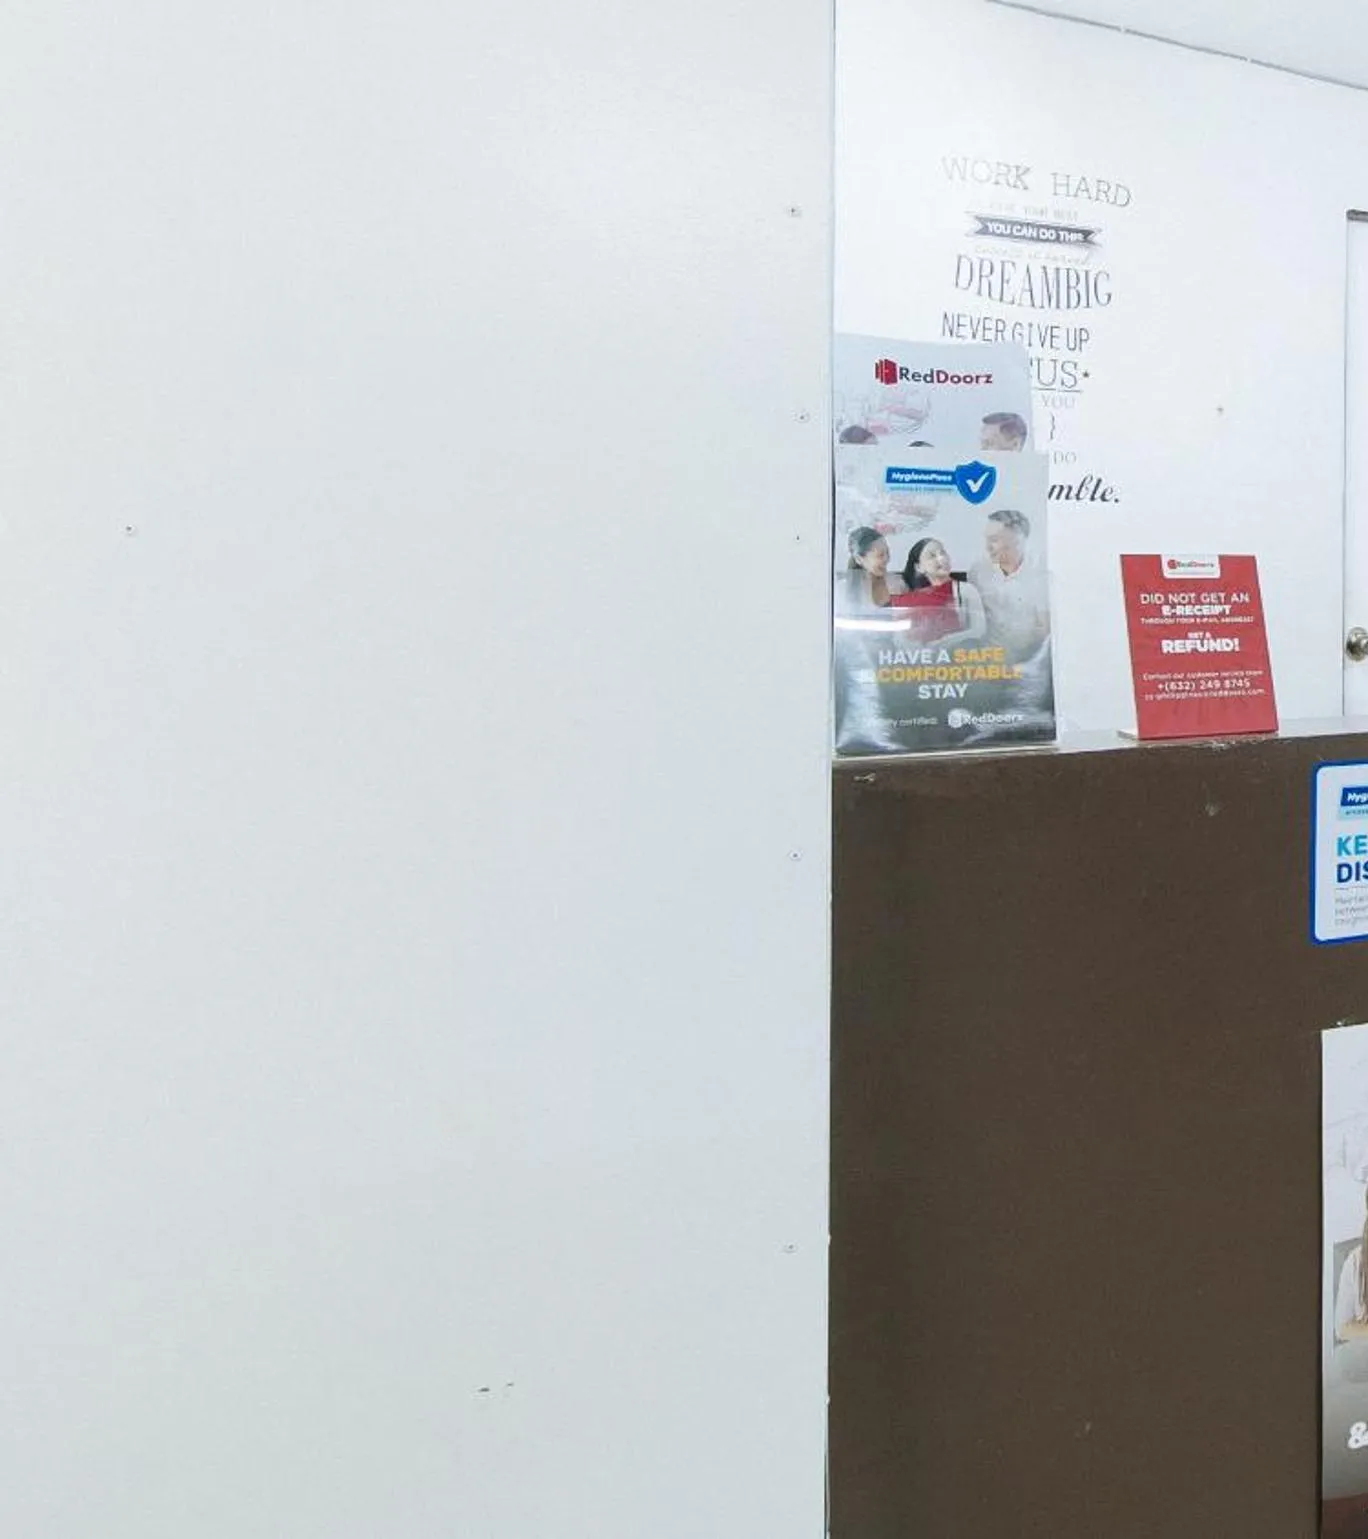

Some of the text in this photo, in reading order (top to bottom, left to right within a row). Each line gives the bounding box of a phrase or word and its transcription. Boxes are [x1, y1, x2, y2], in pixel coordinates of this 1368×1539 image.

[941, 156, 1132, 208] WORK HARD
[986, 222, 1011, 235] YOU
[1013, 225, 1037, 238] CAN
[1039, 229, 1056, 240] DO
[942, 313, 1090, 352] NEVER GIVE UP
[899, 366, 993, 385] RedDoorz
[1030, 357, 1078, 389] US
[1053, 451, 1077, 464] DO
[1140, 592, 1250, 605] DID NOT GET AN
[1161, 605, 1231, 616] E-RECEIPT
[1161, 638, 1240, 653] REFUND!
[879, 647, 1005, 665] HAVE A SAFE
[878, 664, 1023, 682] COMFORTABLE
[918, 683, 968, 700] STAY
